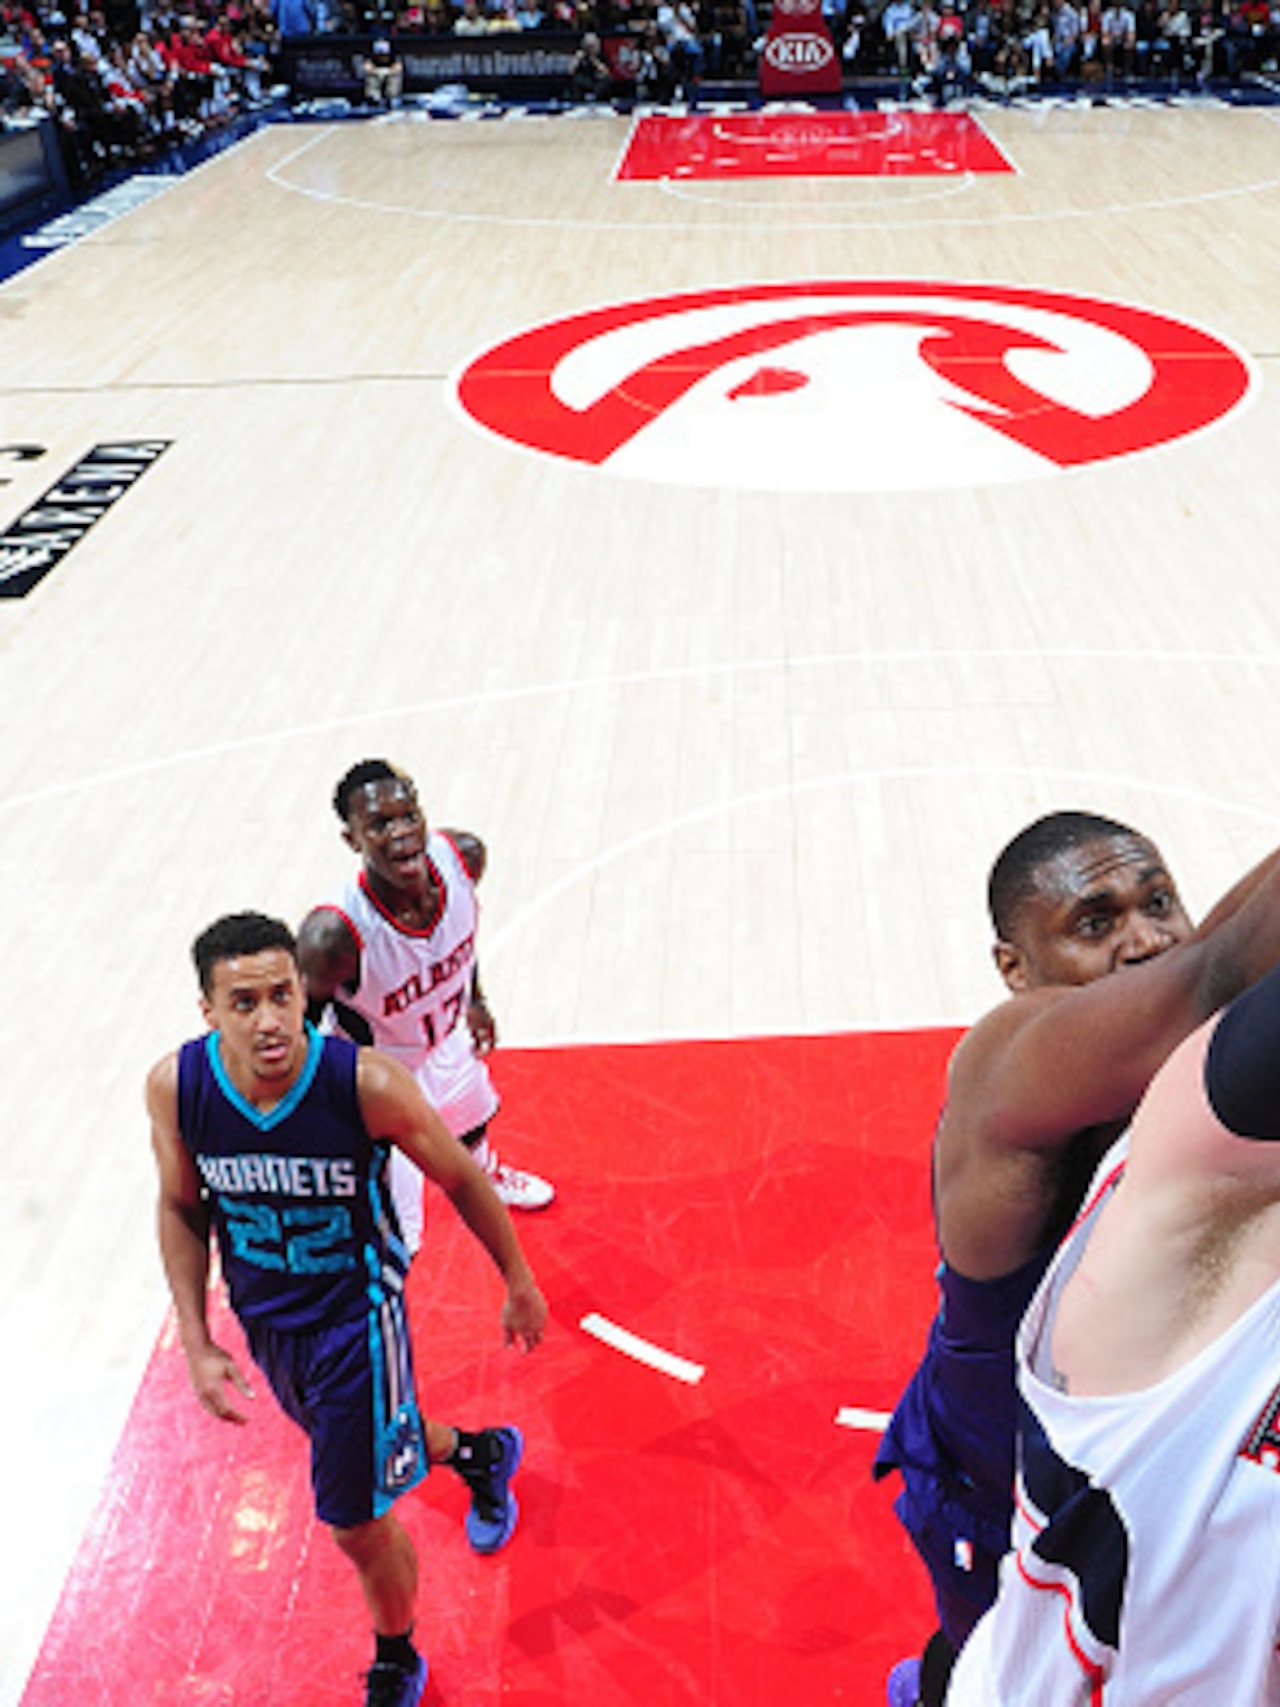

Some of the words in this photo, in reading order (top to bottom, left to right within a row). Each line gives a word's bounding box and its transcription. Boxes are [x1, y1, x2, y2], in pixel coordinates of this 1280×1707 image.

[778, 40, 821, 63] KIA
[418, 984, 466, 1050] 17
[197, 1154, 357, 1198] HORNETS
[219, 1199, 356, 1274] 22
